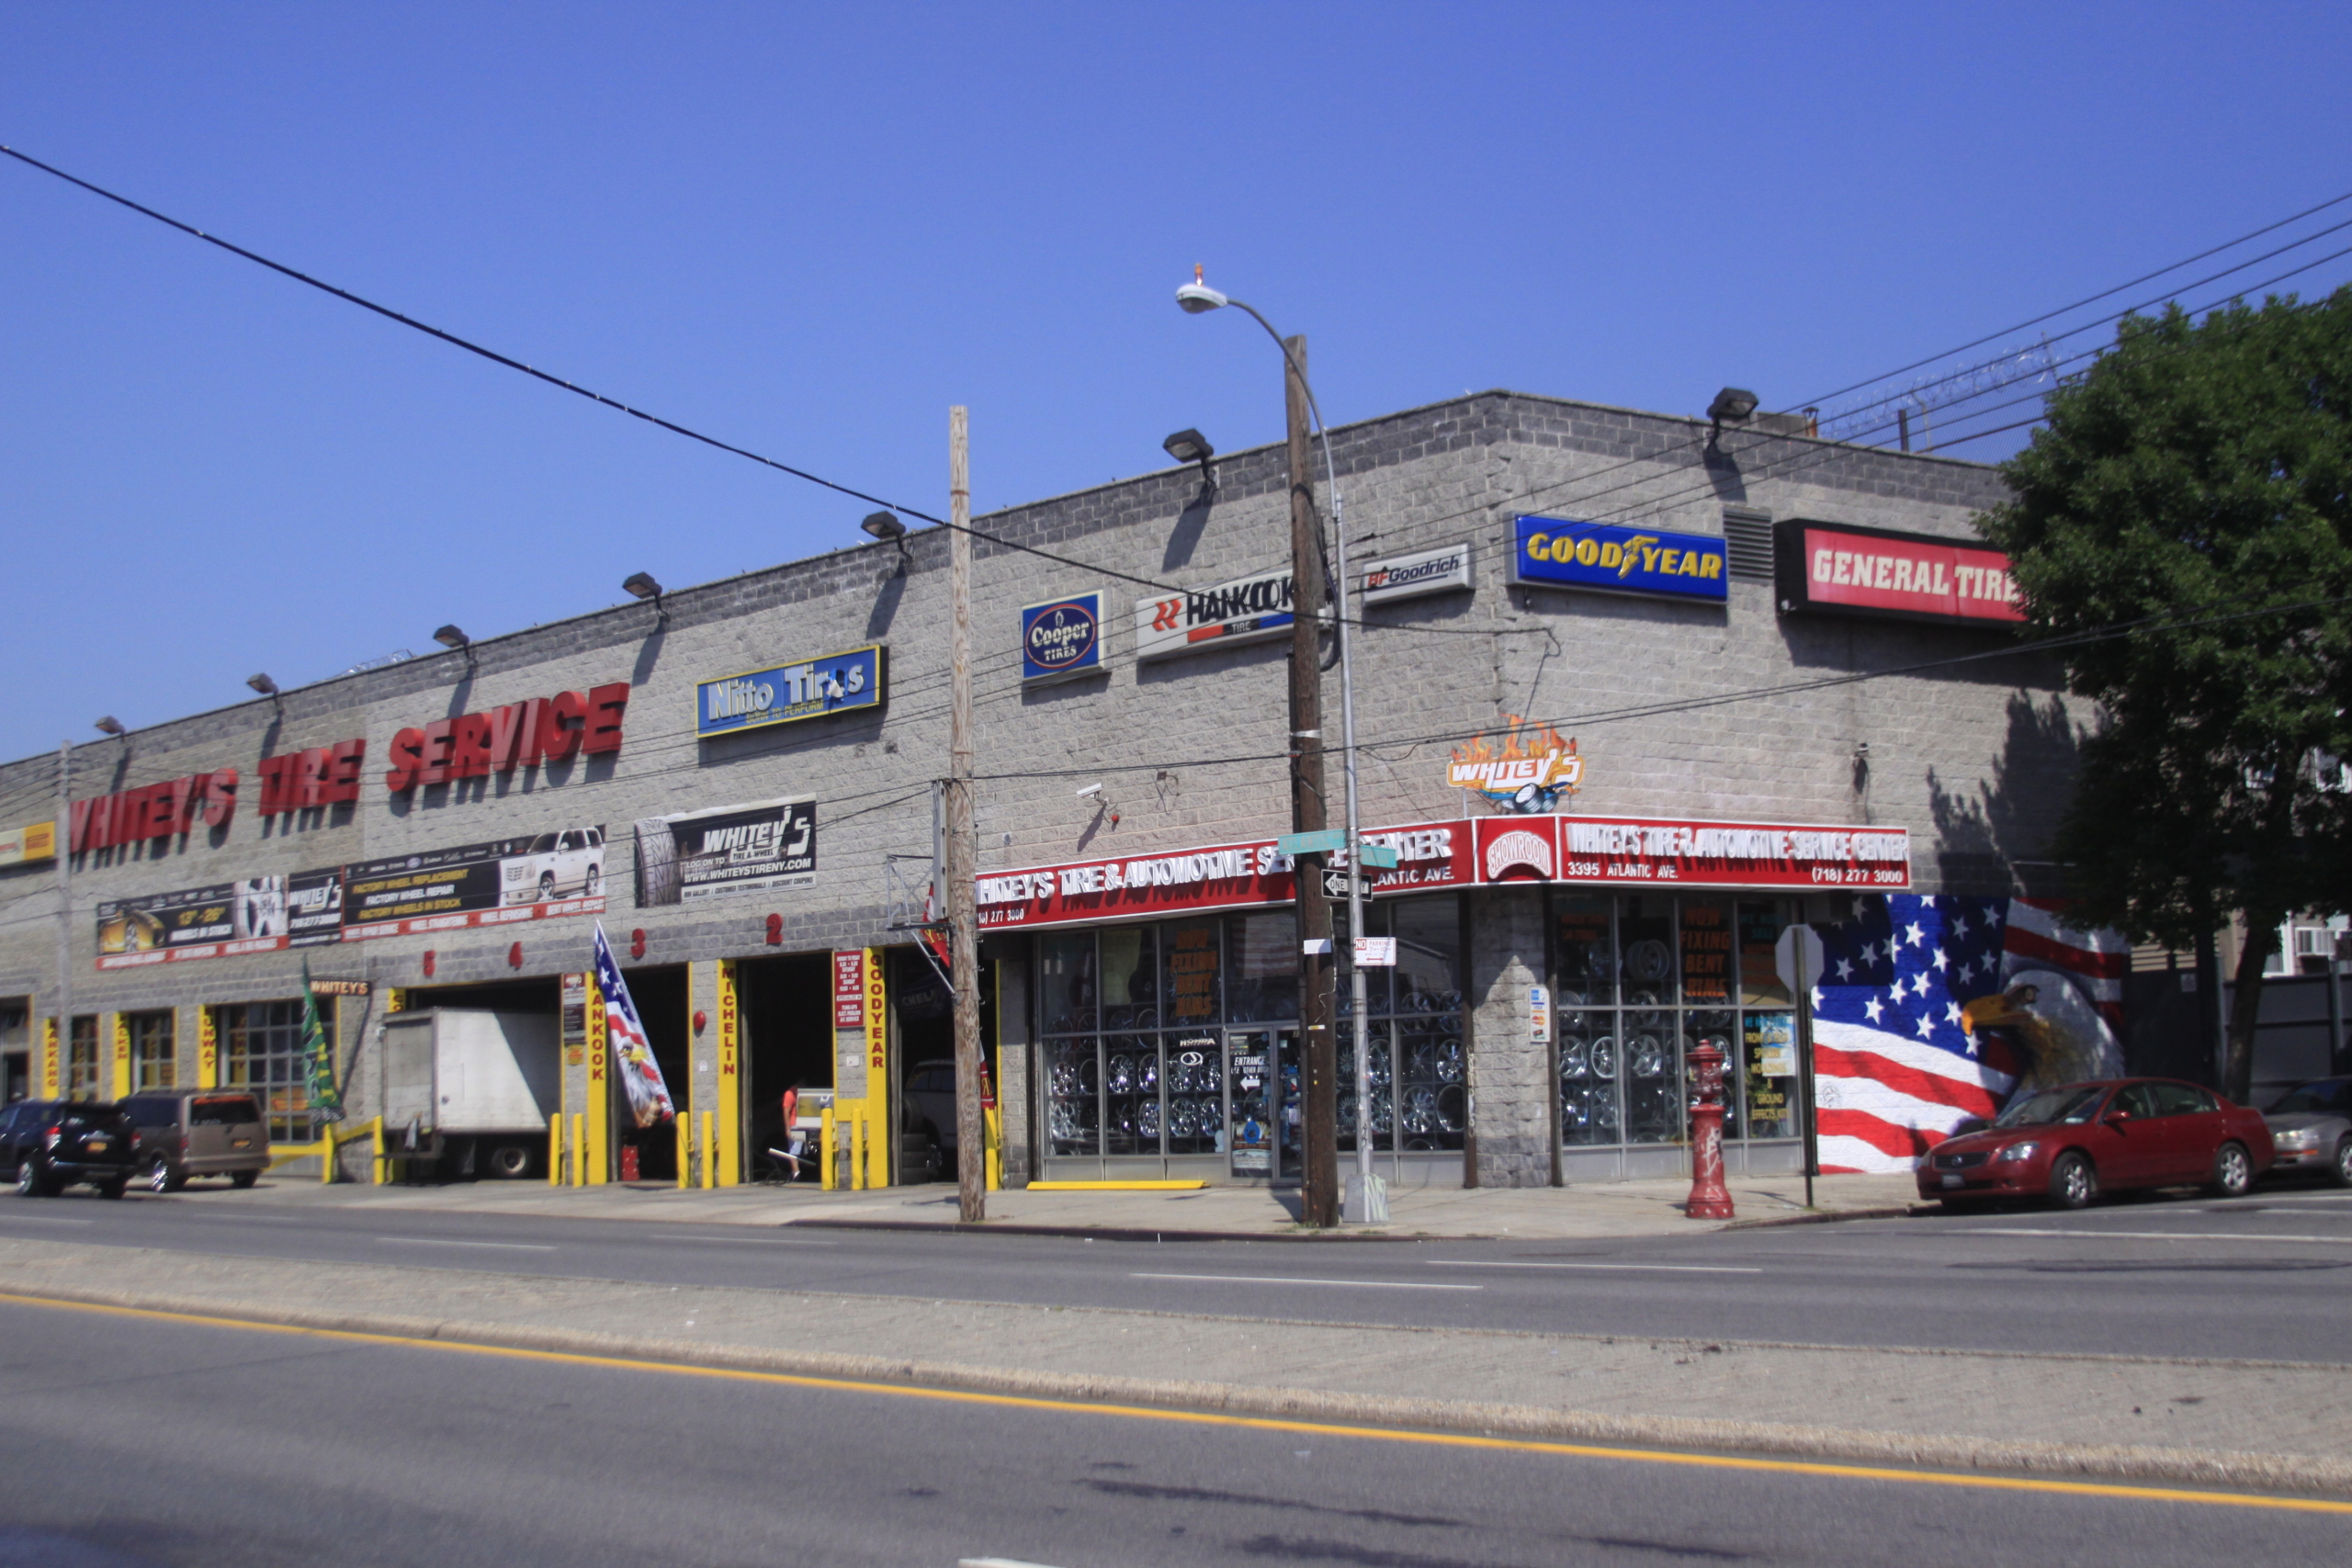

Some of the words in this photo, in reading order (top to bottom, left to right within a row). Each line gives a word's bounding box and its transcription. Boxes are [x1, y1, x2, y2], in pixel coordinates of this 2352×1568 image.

[1527, 533, 1723, 579] GOODYEAR
[1367, 556, 1459, 587] BFGoodrich
[1813, 549, 1949, 595] GENERAL
[1187, 577, 1294, 626] HANKOOK
[1031, 623, 1090, 648] Cooper
[1231, 622, 1250, 634] TIRE
[1044, 645, 1077, 661] TIRES
[707, 679, 774, 720] Nitto
[785, 663, 864, 705] Tirs
[258, 739, 366, 816] TIRE
[386, 682, 630, 791] SERVICE
[1452, 749, 1580, 788] WHITEY'S
[704, 806, 810, 863] WHITEY'S
[1565, 823, 1641, 854] WHITEY'S
[1641, 827, 1679, 856] TIRE
[1679, 827, 1693, 857] &
[1694, 829, 1789, 859] AUTOMOTIVE
[1788, 831, 1851, 860] SERVICE
[1851, 833, 1907, 861] CENTER
[686, 859, 702, 869] LOG
[703, 858, 714, 867] ON
[715, 856, 725, 866] TO
[733, 852, 746, 861] TIRE
[753, 848, 774, 858] WHEEL
[1488, 832, 1551, 876] SHOWROOM
[684, 858, 811, 884] WWW.WHITEYSTIRENY.COM
[976, 871, 1054, 905] HITEY'S
[1058, 865, 1105, 897] TIRE
[1105, 863, 1124, 891] &
[1124, 848, 1254, 888] AUTOMOTIVE
[1424, 865, 1454, 882] AVE.
[1567, 862, 1600, 875] 3395
[1607, 863, 1651, 878] ATLANTIC
[1657, 864, 1679, 879] AVE.
[1812, 867, 1842, 883] (718)
[1846, 869, 1869, 882] 277
[1873, 870, 1903, 883] 3000
[400, 888, 425, 900] WHEEL
[425, 884, 455, 897] REPAIR
[772, 878, 793, 887] DISCOUNT
[1330, 880, 1344, 890] ONE
[990, 911, 1004, 922] 277
[1007, 908, 1024, 921] 3000
[765, 913, 784, 945] 2
[630, 928, 646, 958] 3
[1355, 940, 1366, 949] NO
[1679, 931, 1731, 950] FIXING
[423, 950, 436, 977] 5
[508, 941, 523, 969] 4
[1685, 954, 1724, 973] BENT
[309, 980, 368, 996] WHITEY'S
[1686, 978, 1725, 997] RIMS
[722, 967, 735, 1075] MICHELIN
[870, 953, 884, 1068] GOODYEAR
[1234, 1055, 1266, 1066] ENTRANCE
[1758, 1093, 1783, 1104] GROUND
[1753, 1109, 1775, 1120] EFFECTS
